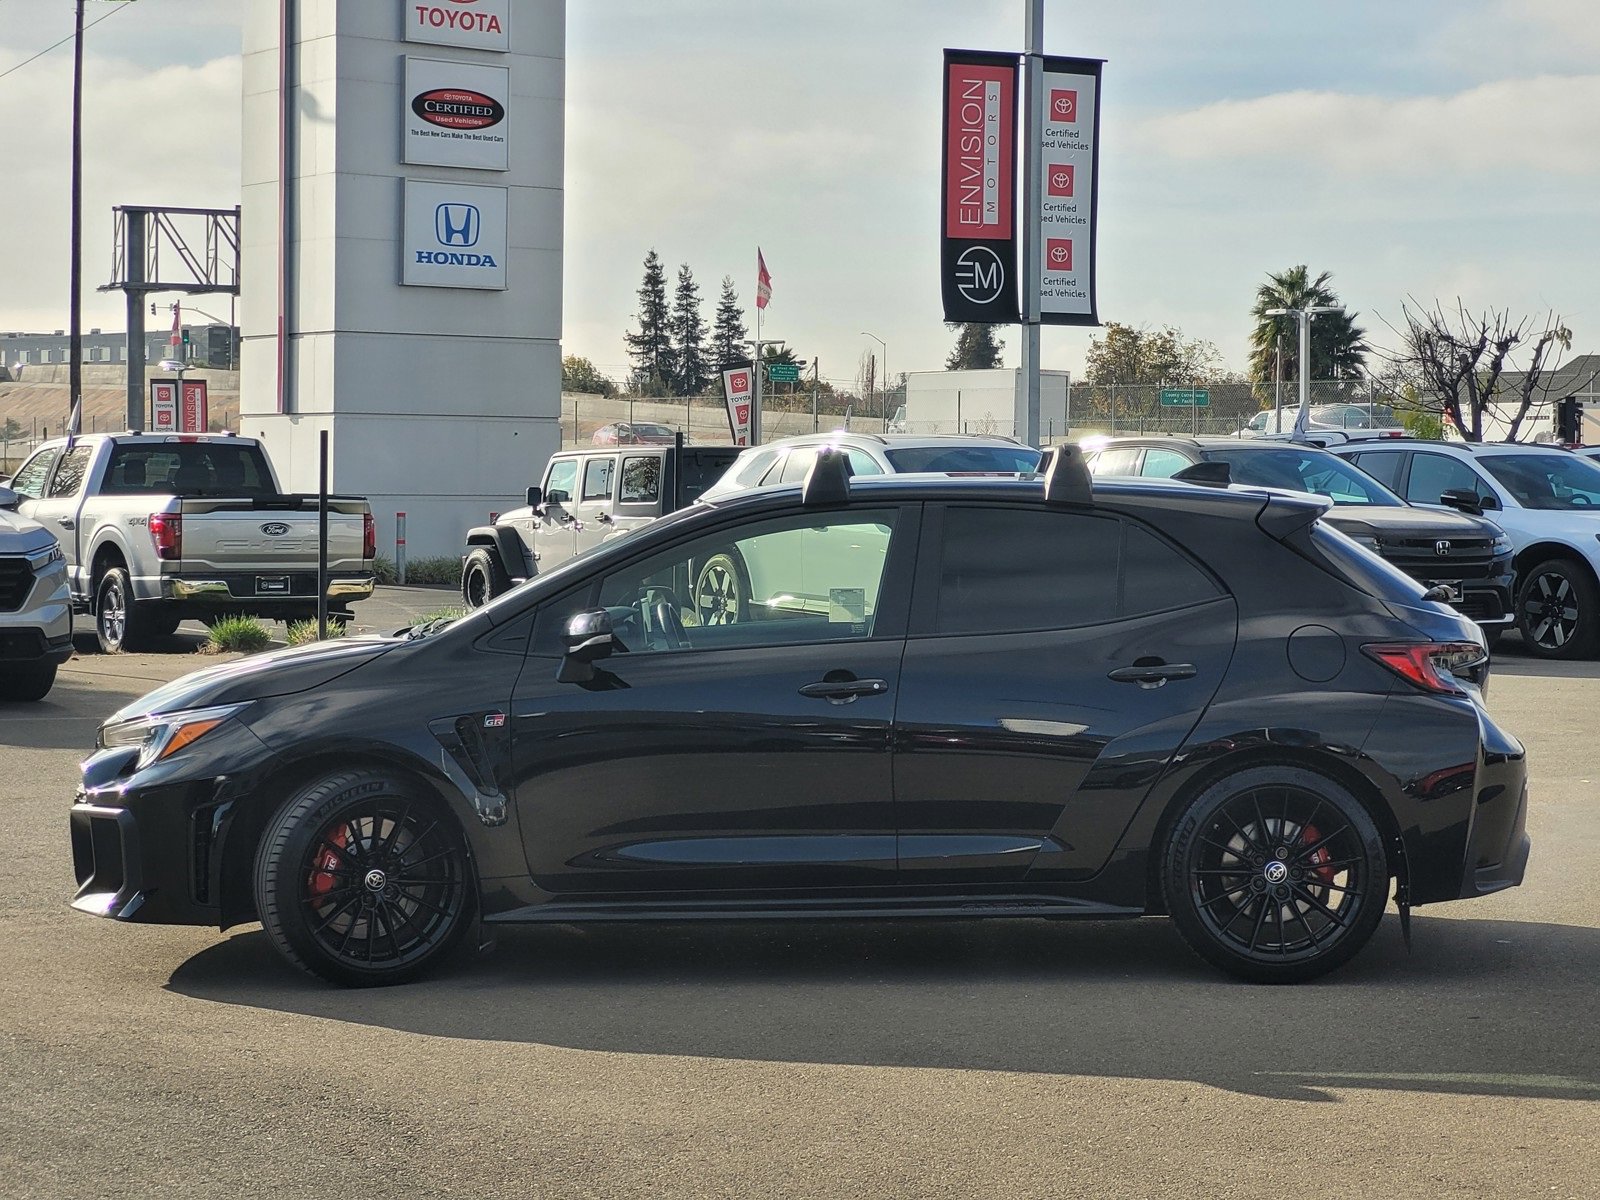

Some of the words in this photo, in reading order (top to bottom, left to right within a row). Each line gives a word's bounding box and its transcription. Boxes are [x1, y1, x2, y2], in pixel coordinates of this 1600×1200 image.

[416, 6, 502, 34] TOYOTA
[424, 101, 493, 116] CERTIFIED
[454, 117, 482, 125] Vehicles
[1045, 128, 1079, 138] Certified
[1041, 140, 1055, 148] sed
[1057, 141, 1089, 150] Vehicles
[960, 79, 983, 224] ENVISION
[987, 94, 997, 213] MOTORS
[1043, 203, 1077, 212] Certified
[1040, 214, 1053, 222] sed
[1055, 215, 1087, 224] Vehicles
[416, 251, 497, 267] HONDA
[1042, 277, 1076, 286] Certified
[1040, 288, 1053, 296] sed
[1055, 289, 1086, 298] Vehicles
[731, 395, 751, 403] TOYOTA
[187, 387, 195, 432] ENVISION
[266, 524, 285, 535] Ford
